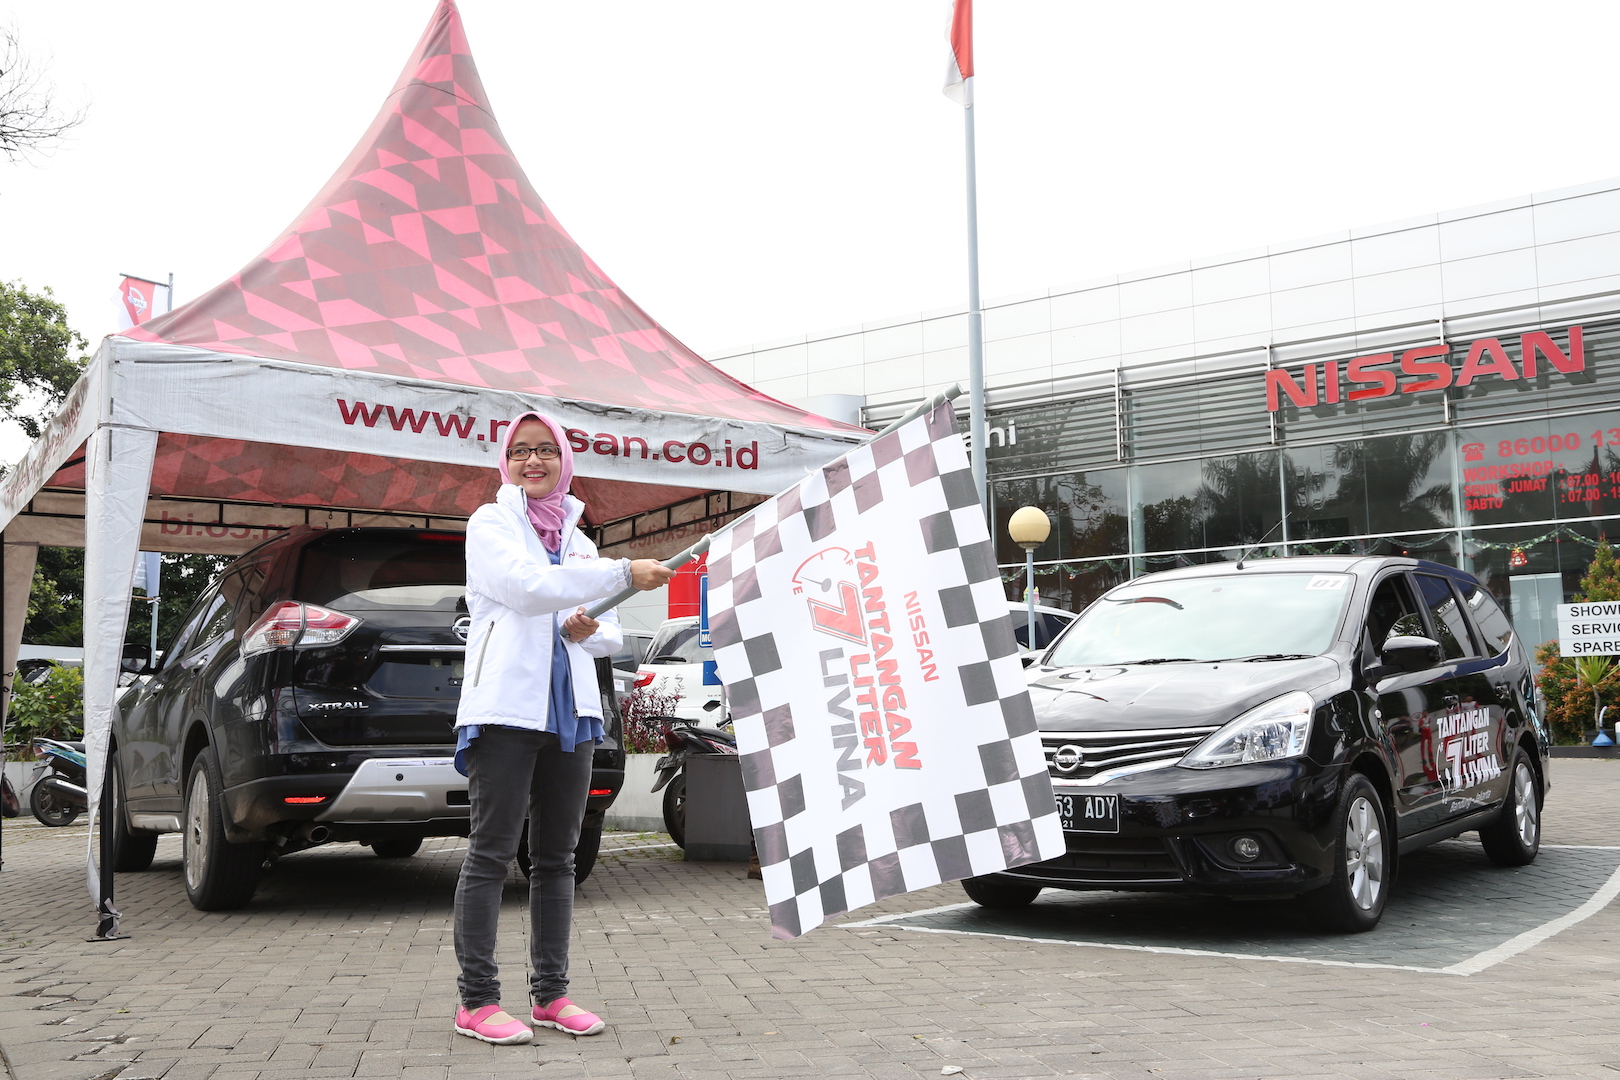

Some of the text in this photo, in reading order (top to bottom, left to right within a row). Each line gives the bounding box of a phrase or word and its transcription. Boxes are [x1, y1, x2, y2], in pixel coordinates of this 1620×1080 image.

[1265, 326, 1585, 412] NISSAN
[337, 398, 758, 470] www.nsan.co.id
[1497, 432, 1581, 458] 86000
[1463, 460, 1554, 483] WORKSHOP
[1463, 482, 1499, 497] SENIN
[1508, 478, 1547, 493] JUMAT
[1566, 473, 1599, 488] 07.00
[1465, 497, 1504, 511] SABTU
[1567, 488, 1600, 503] 07.00
[904, 590, 939, 683] NISSAN
[1573, 640, 1620, 653] SPARE
[854, 540, 922, 770] TANTANGAN
[807, 580, 888, 769] 7 LITER
[308, 701, 369, 711] X-TRAIL
[819, 647, 866, 812] LIVINA
[1437, 707, 1490, 739] TANTANGAN
[1464, 731, 1489, 758] LITER
[1085, 796, 1116, 819] ADY
